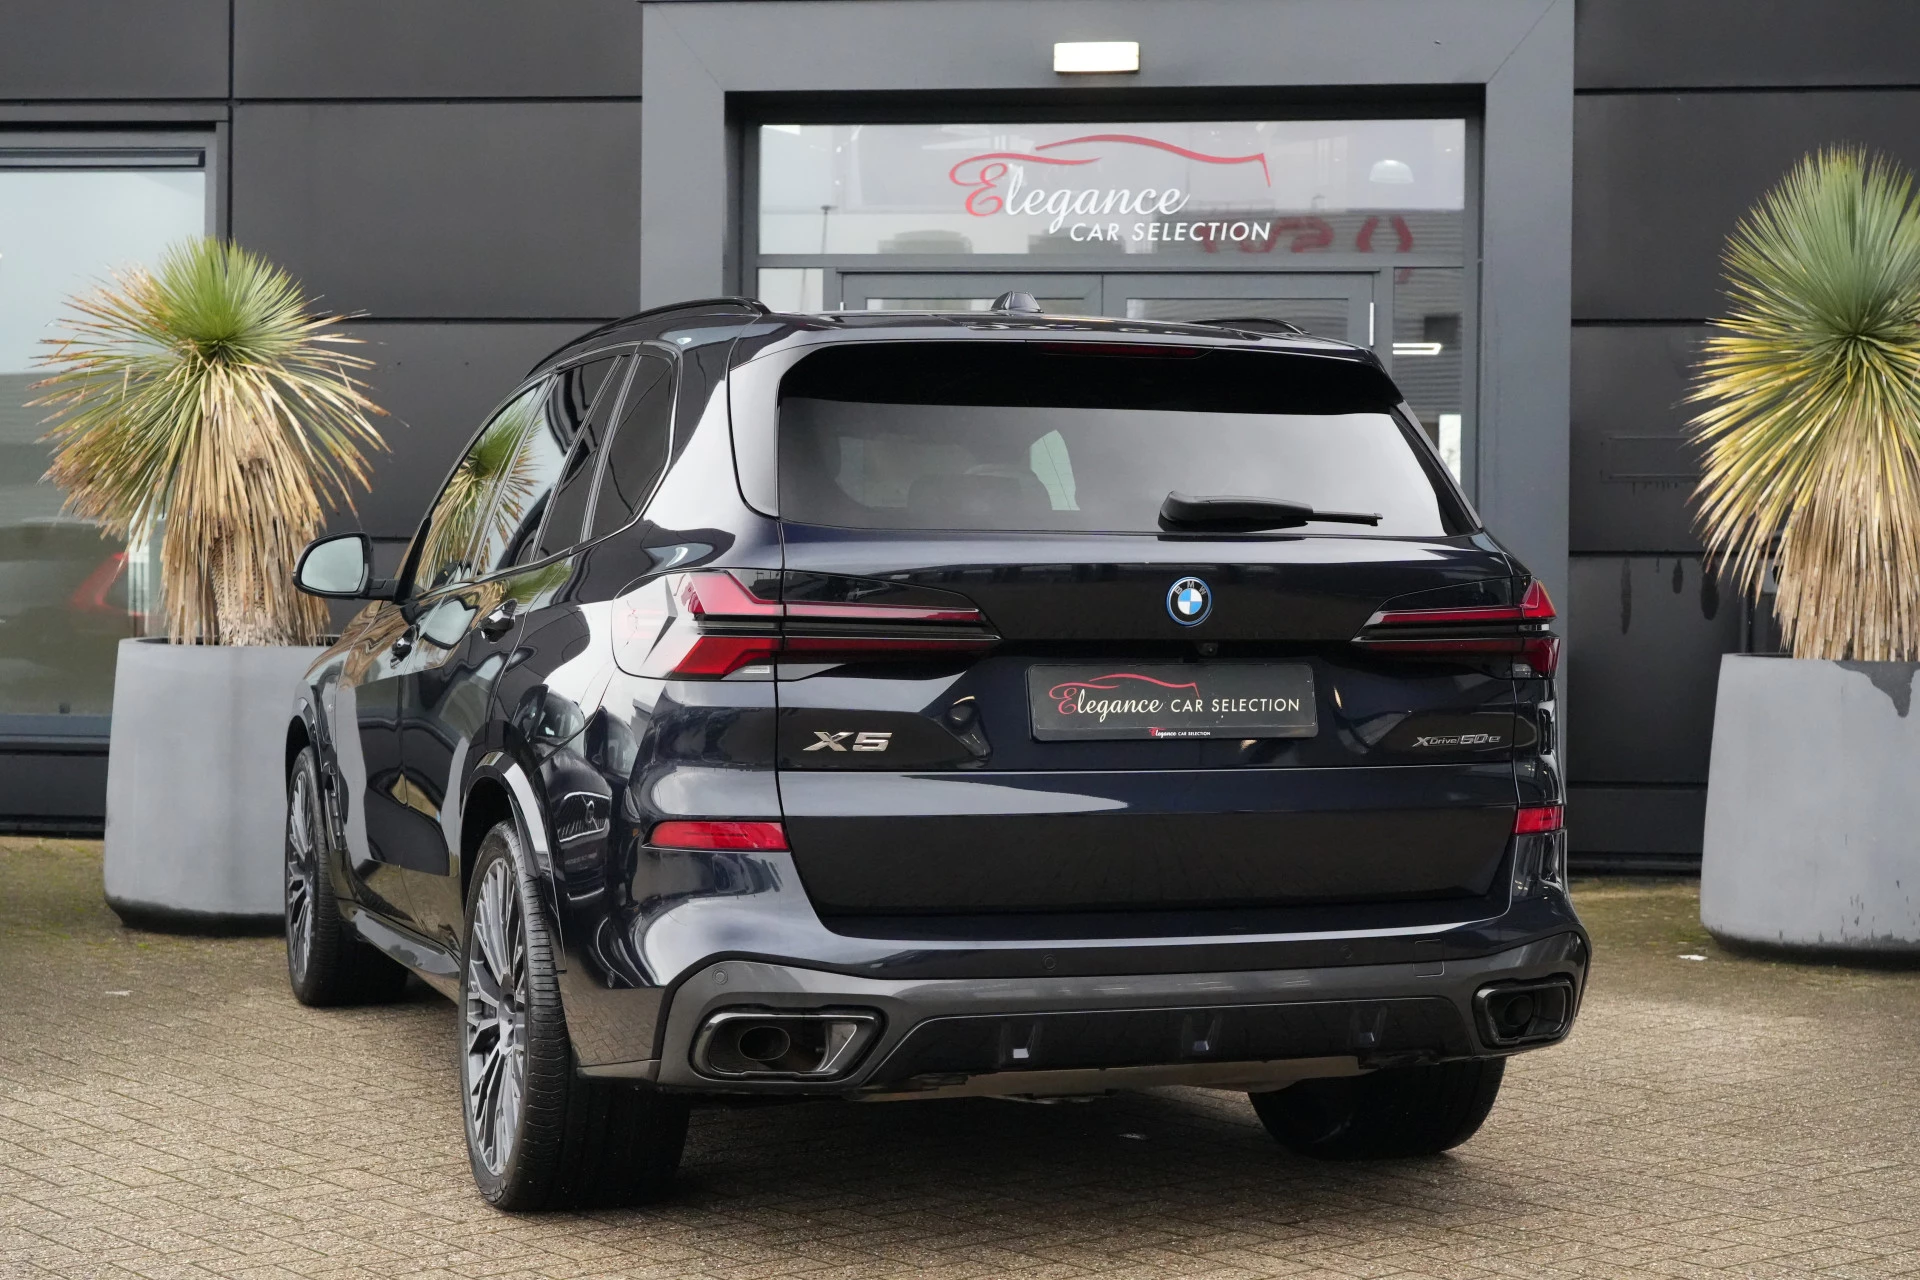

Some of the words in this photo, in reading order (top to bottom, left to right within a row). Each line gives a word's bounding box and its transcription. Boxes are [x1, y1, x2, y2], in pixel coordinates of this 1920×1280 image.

[950, 158, 1191, 234] Elegance
[1070, 222, 1119, 242] CAR
[1131, 221, 1271, 242] SELECTION
[1174, 580, 1207, 595] BMW
[1050, 686, 1163, 723] Elegance
[1170, 699, 1203, 713] CAR
[1211, 698, 1300, 712] SELECTION
[802, 731, 893, 752] X5
